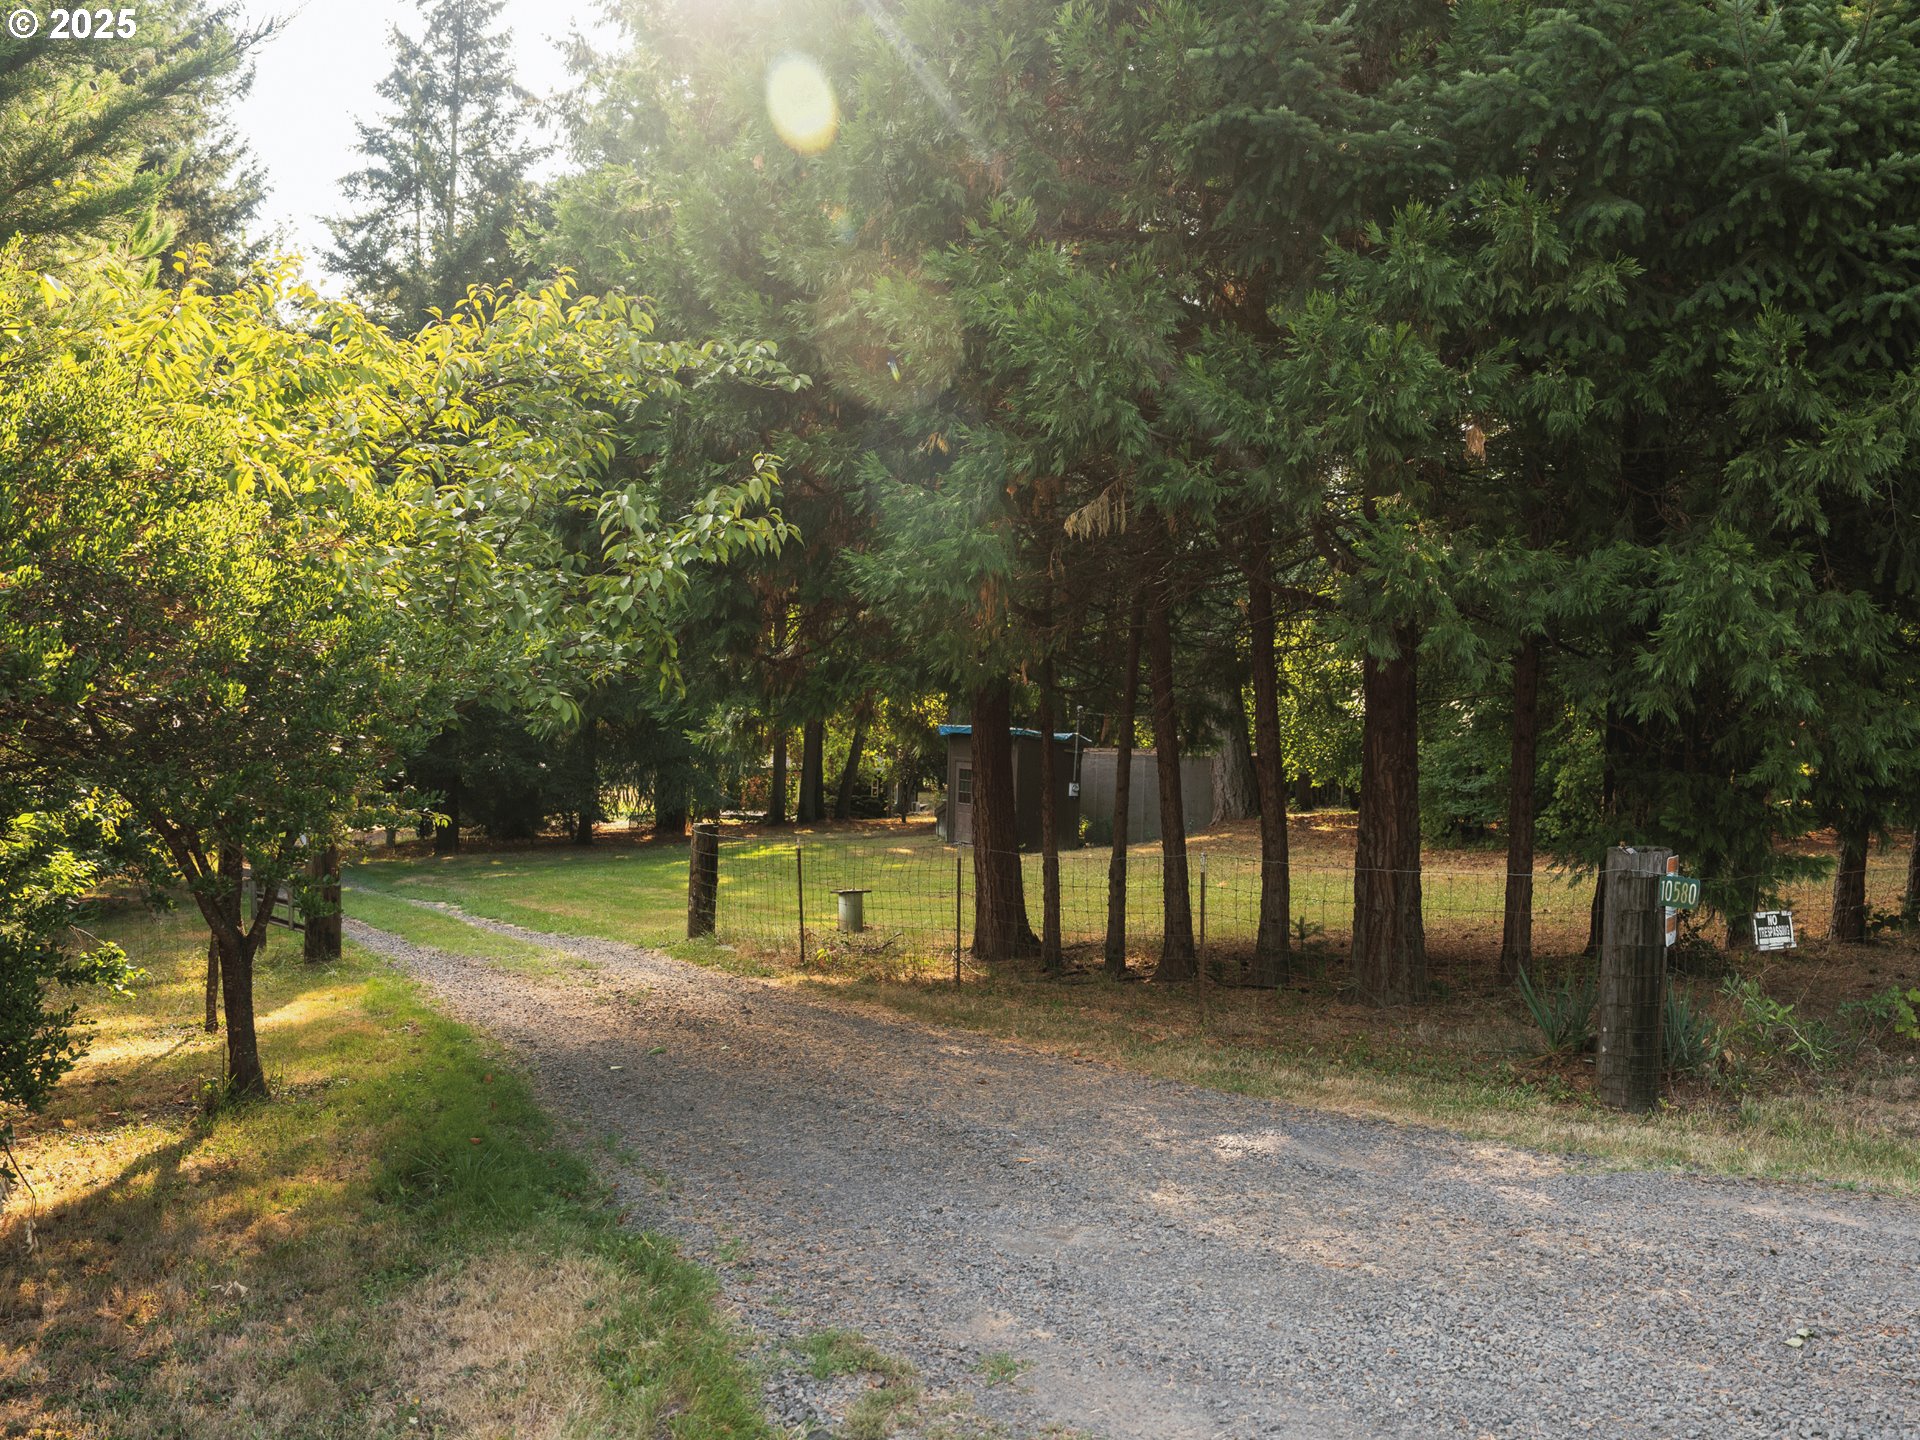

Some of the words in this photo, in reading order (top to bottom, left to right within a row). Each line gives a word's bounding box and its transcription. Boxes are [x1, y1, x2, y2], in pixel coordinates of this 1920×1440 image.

[1661, 879, 1697, 905] 10580
[1767, 914, 1778, 926] NO
[1758, 925, 1790, 938] TRESPASSING
